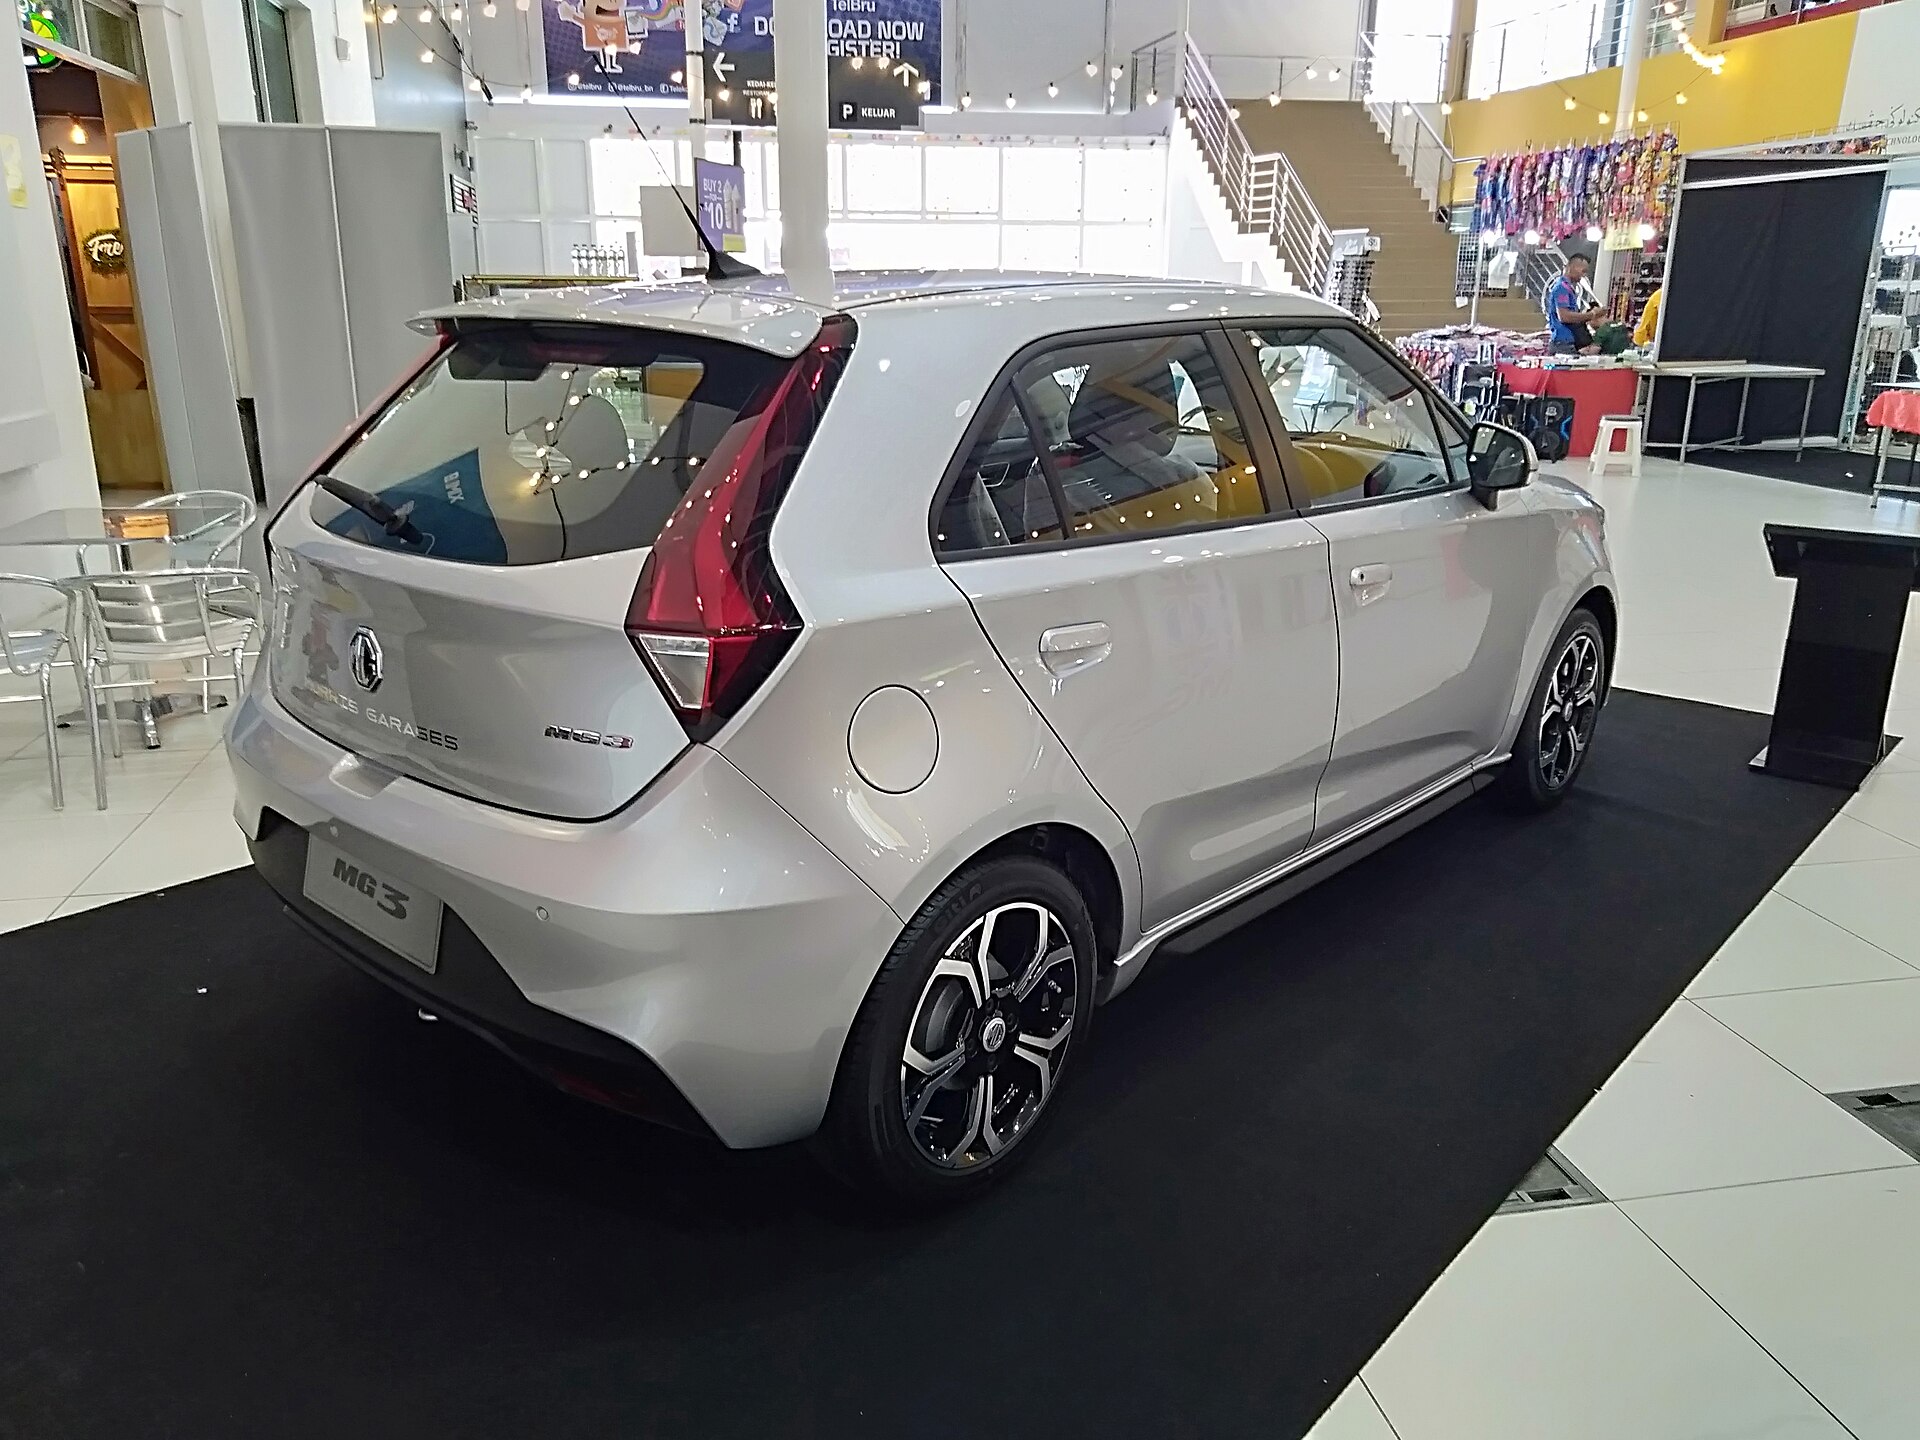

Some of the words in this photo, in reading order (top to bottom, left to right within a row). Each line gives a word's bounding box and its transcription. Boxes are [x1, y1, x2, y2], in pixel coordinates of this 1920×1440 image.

[833, 0, 876, 12] TelBru
[877, 20, 924, 41] NOW
[861, 107, 896, 118] KELUAR
[703, 178, 716, 192] BUY
[717, 180, 722, 193] 2
[365, 707, 459, 751] GARAGES
[544, 724, 634, 749] MG3
